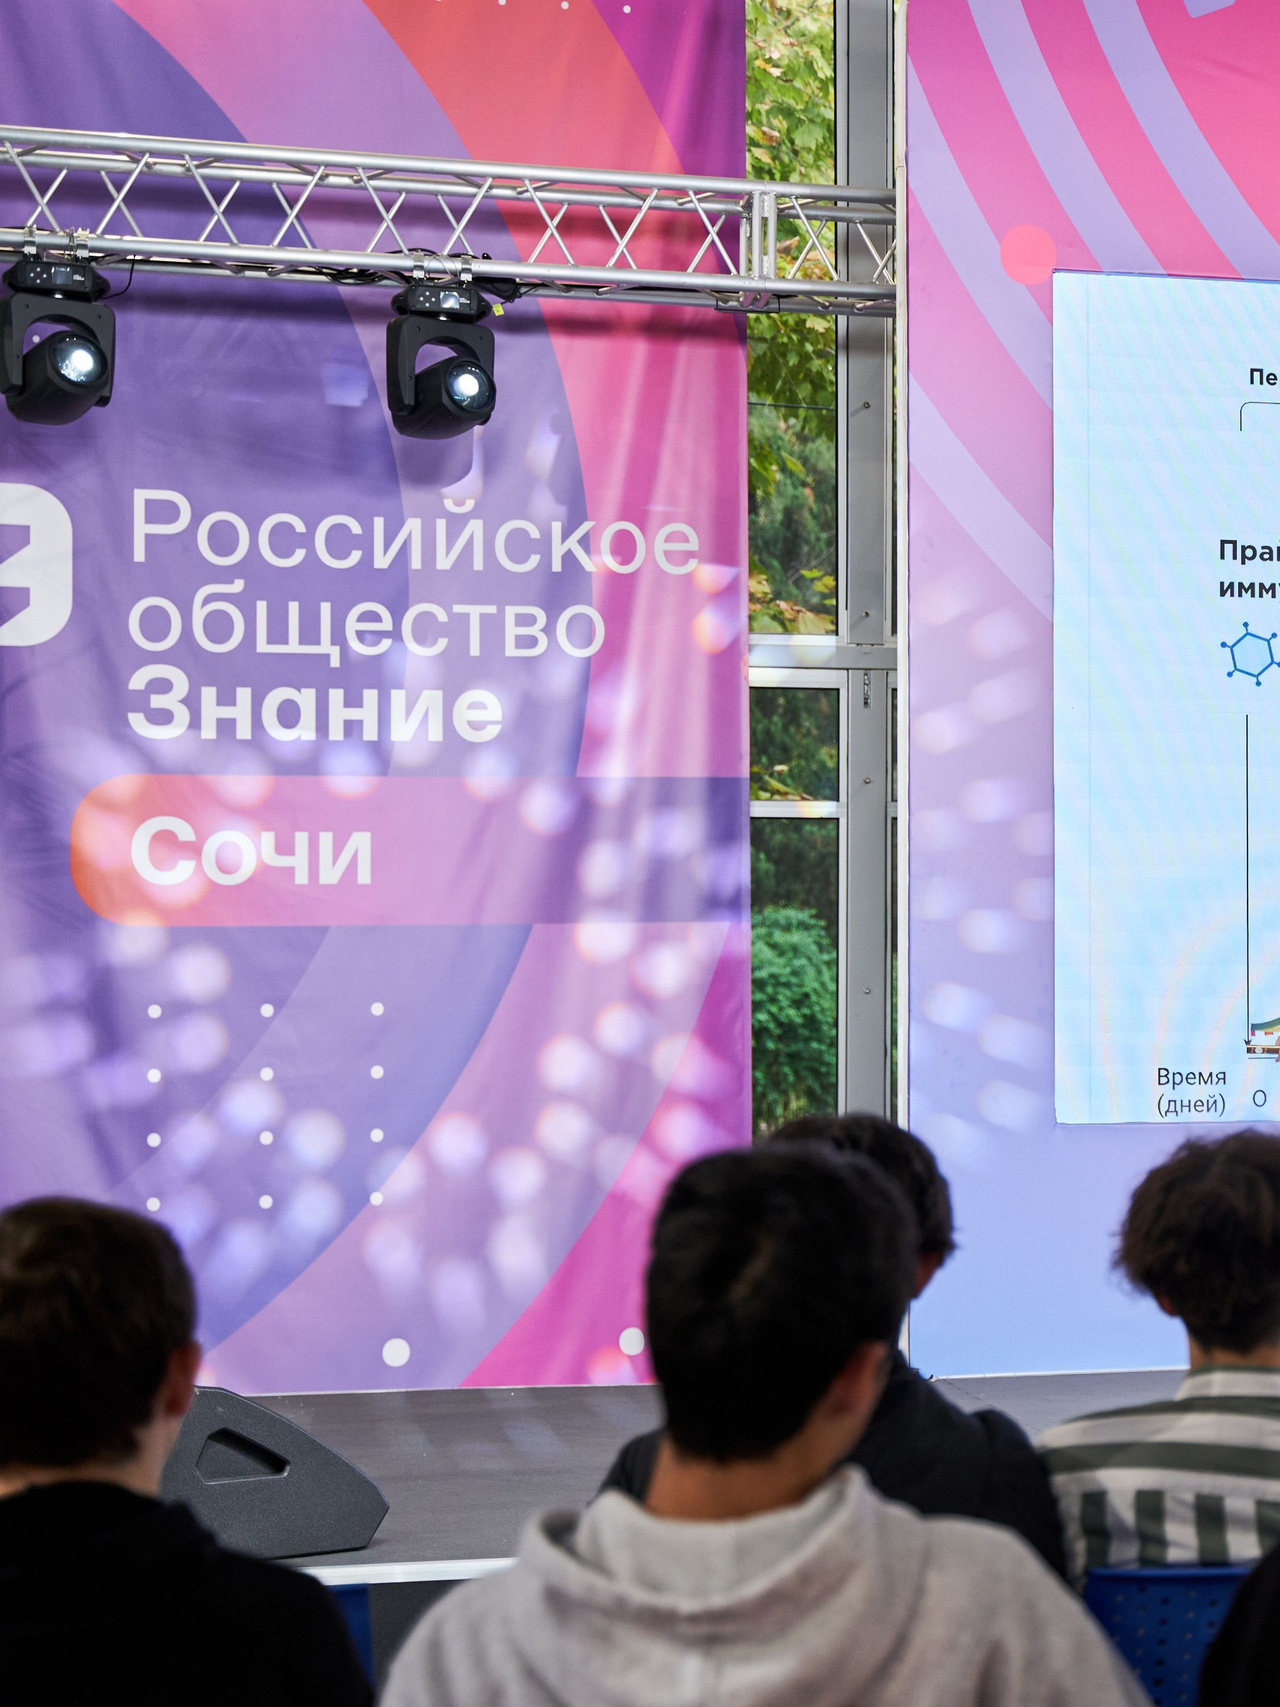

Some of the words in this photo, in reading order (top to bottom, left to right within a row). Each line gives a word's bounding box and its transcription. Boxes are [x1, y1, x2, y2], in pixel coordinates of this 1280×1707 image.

[132, 487, 700, 575] Российское
[127, 579, 606, 667] общество
[126, 663, 503, 743] Знание
[129, 816, 373, 886] Сочи
[1157, 1067, 1227, 1091] Время
[1157, 1092, 1226, 1119] (дней)
